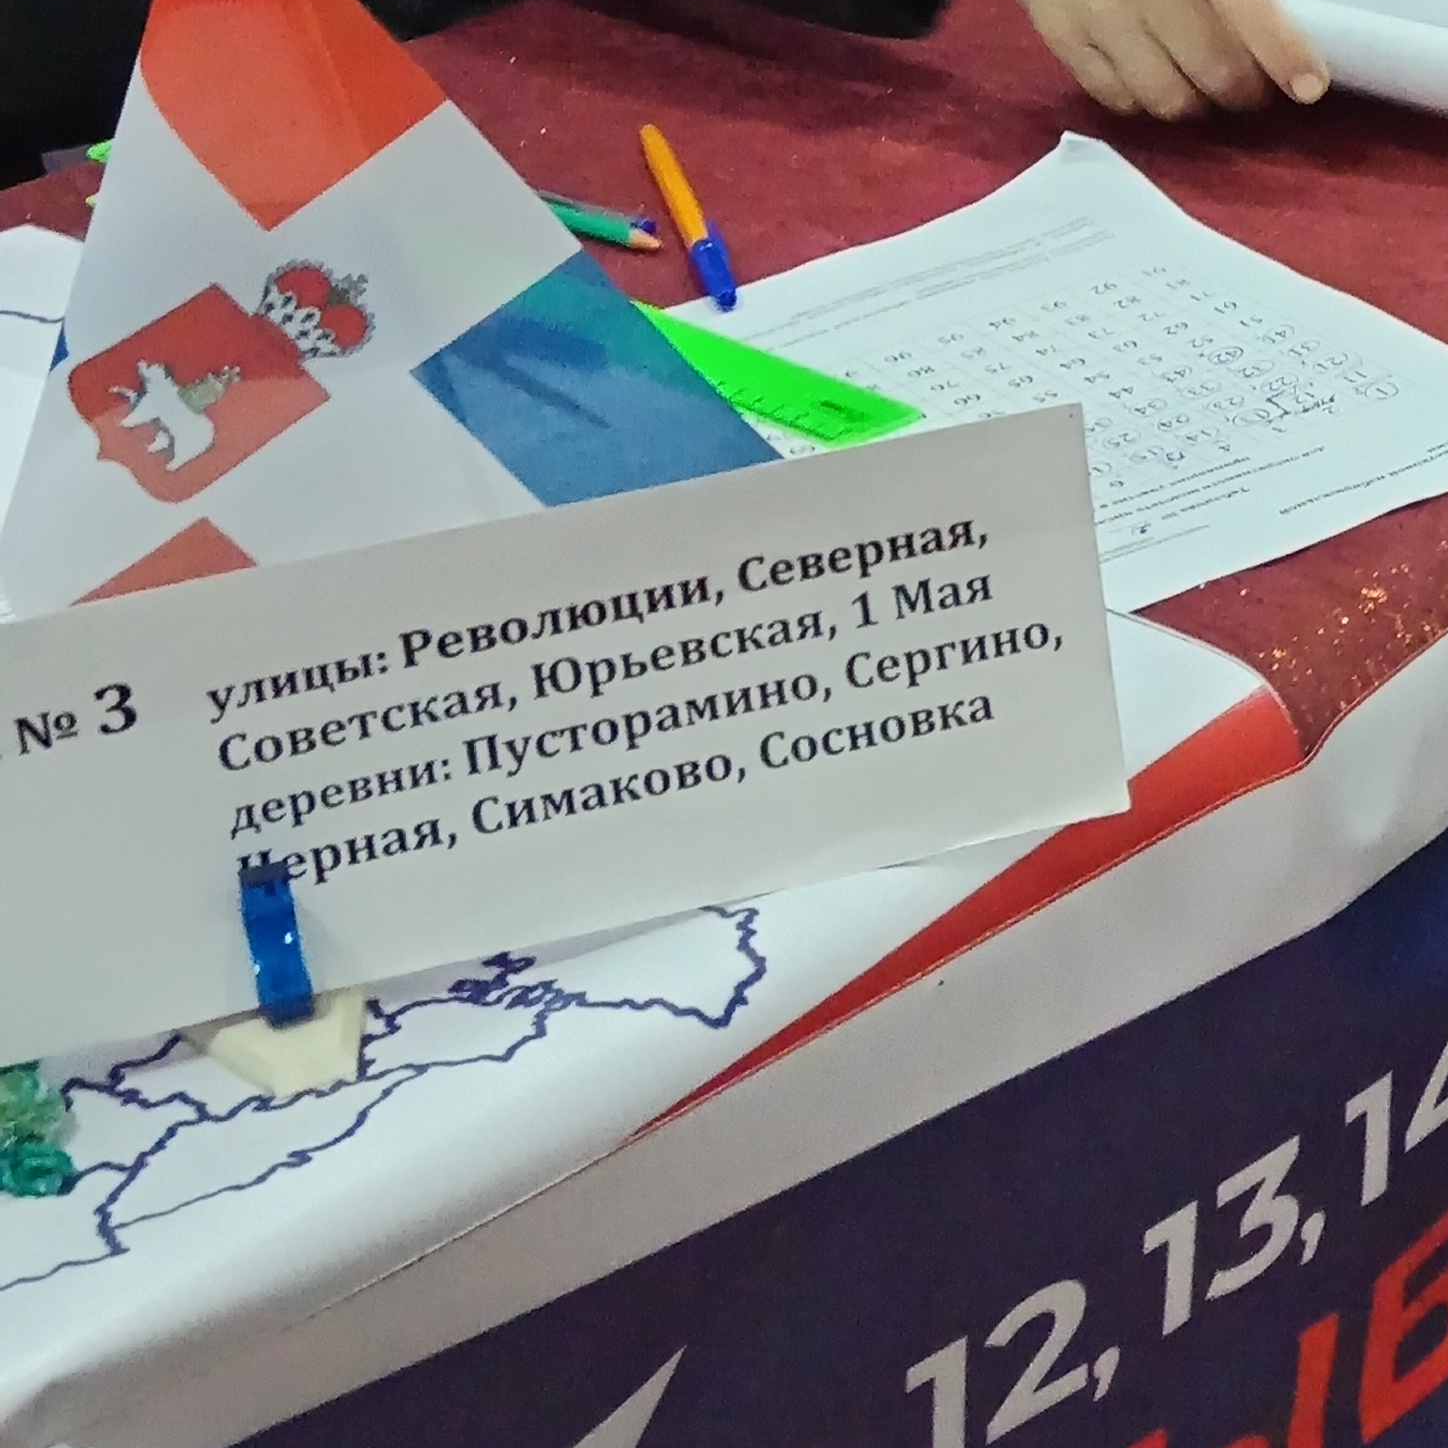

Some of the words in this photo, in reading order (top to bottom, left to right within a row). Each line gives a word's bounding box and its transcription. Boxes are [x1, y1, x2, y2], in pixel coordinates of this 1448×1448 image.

[16, 711, 80, 757] №
[95, 683, 137, 735] 3
[206, 649, 390, 724] улицы:
[399, 575, 725, 670] Революции,
[737, 518, 989, 593] Северная,
[218, 679, 518, 772] Советская,
[531, 609, 838, 702] Юрьевская,
[851, 592, 879, 629] 1
[893, 573, 994, 622] Мая
[230, 758, 453, 840] деревни:
[462, 670, 833, 779] Пусторамино,
[845, 620, 1064, 690] Сергино,
[471, 751, 748, 838] Симаково,
[759, 694, 996, 771] Сосновка
[1142, 1134, 1327, 1336] 13,
